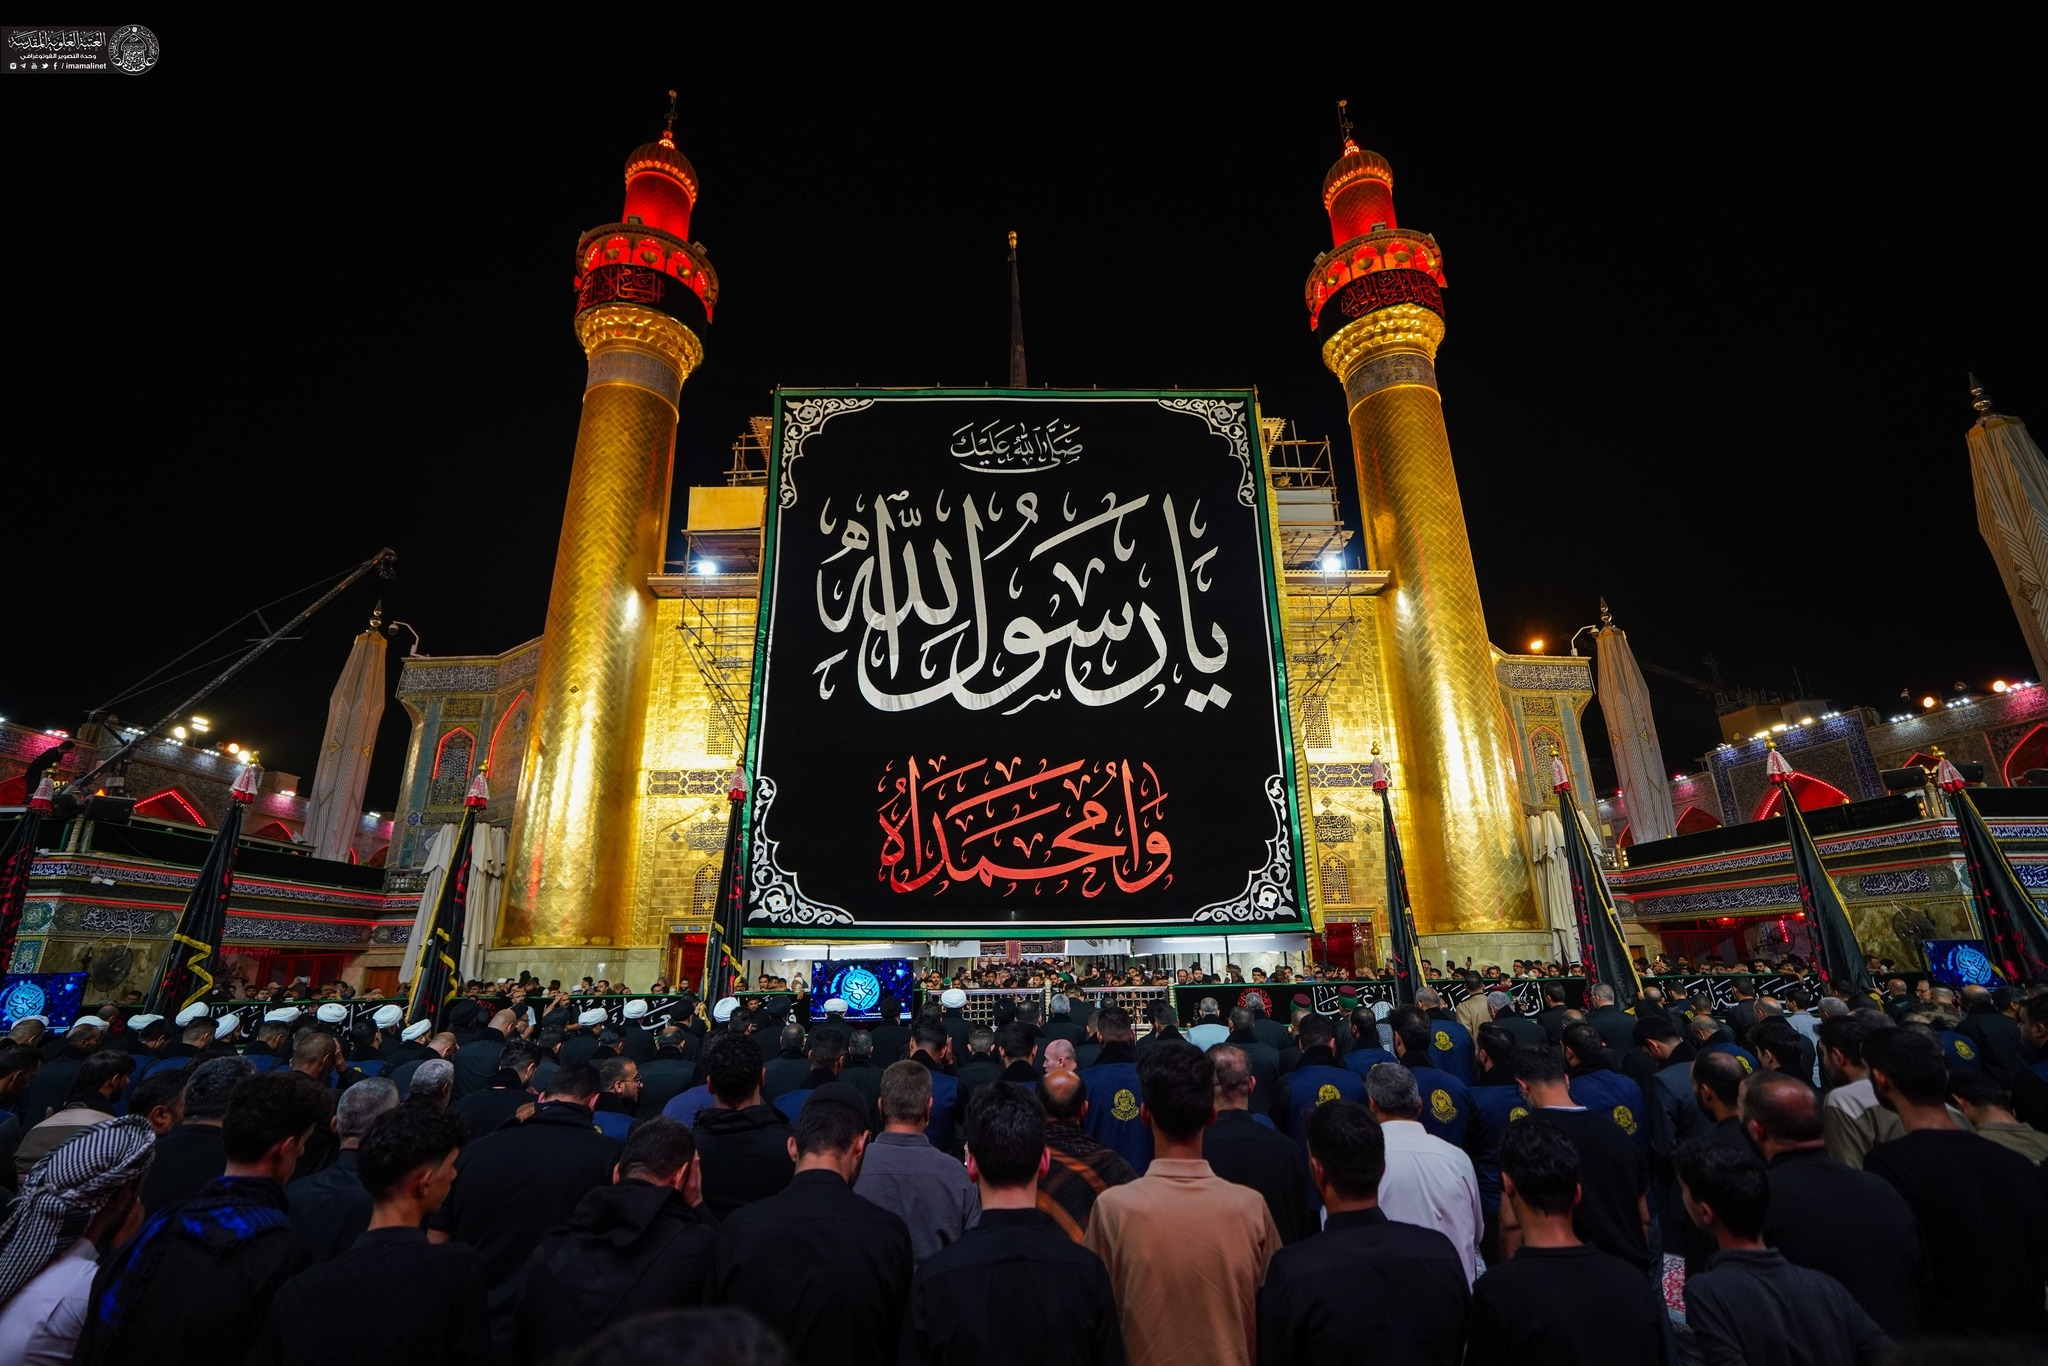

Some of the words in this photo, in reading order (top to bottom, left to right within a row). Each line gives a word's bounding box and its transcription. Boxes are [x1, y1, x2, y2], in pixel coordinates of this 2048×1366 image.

[816, 490, 959, 680] الله
[857, 492, 1168, 713] رسول
[1161, 492, 1233, 713] يا
